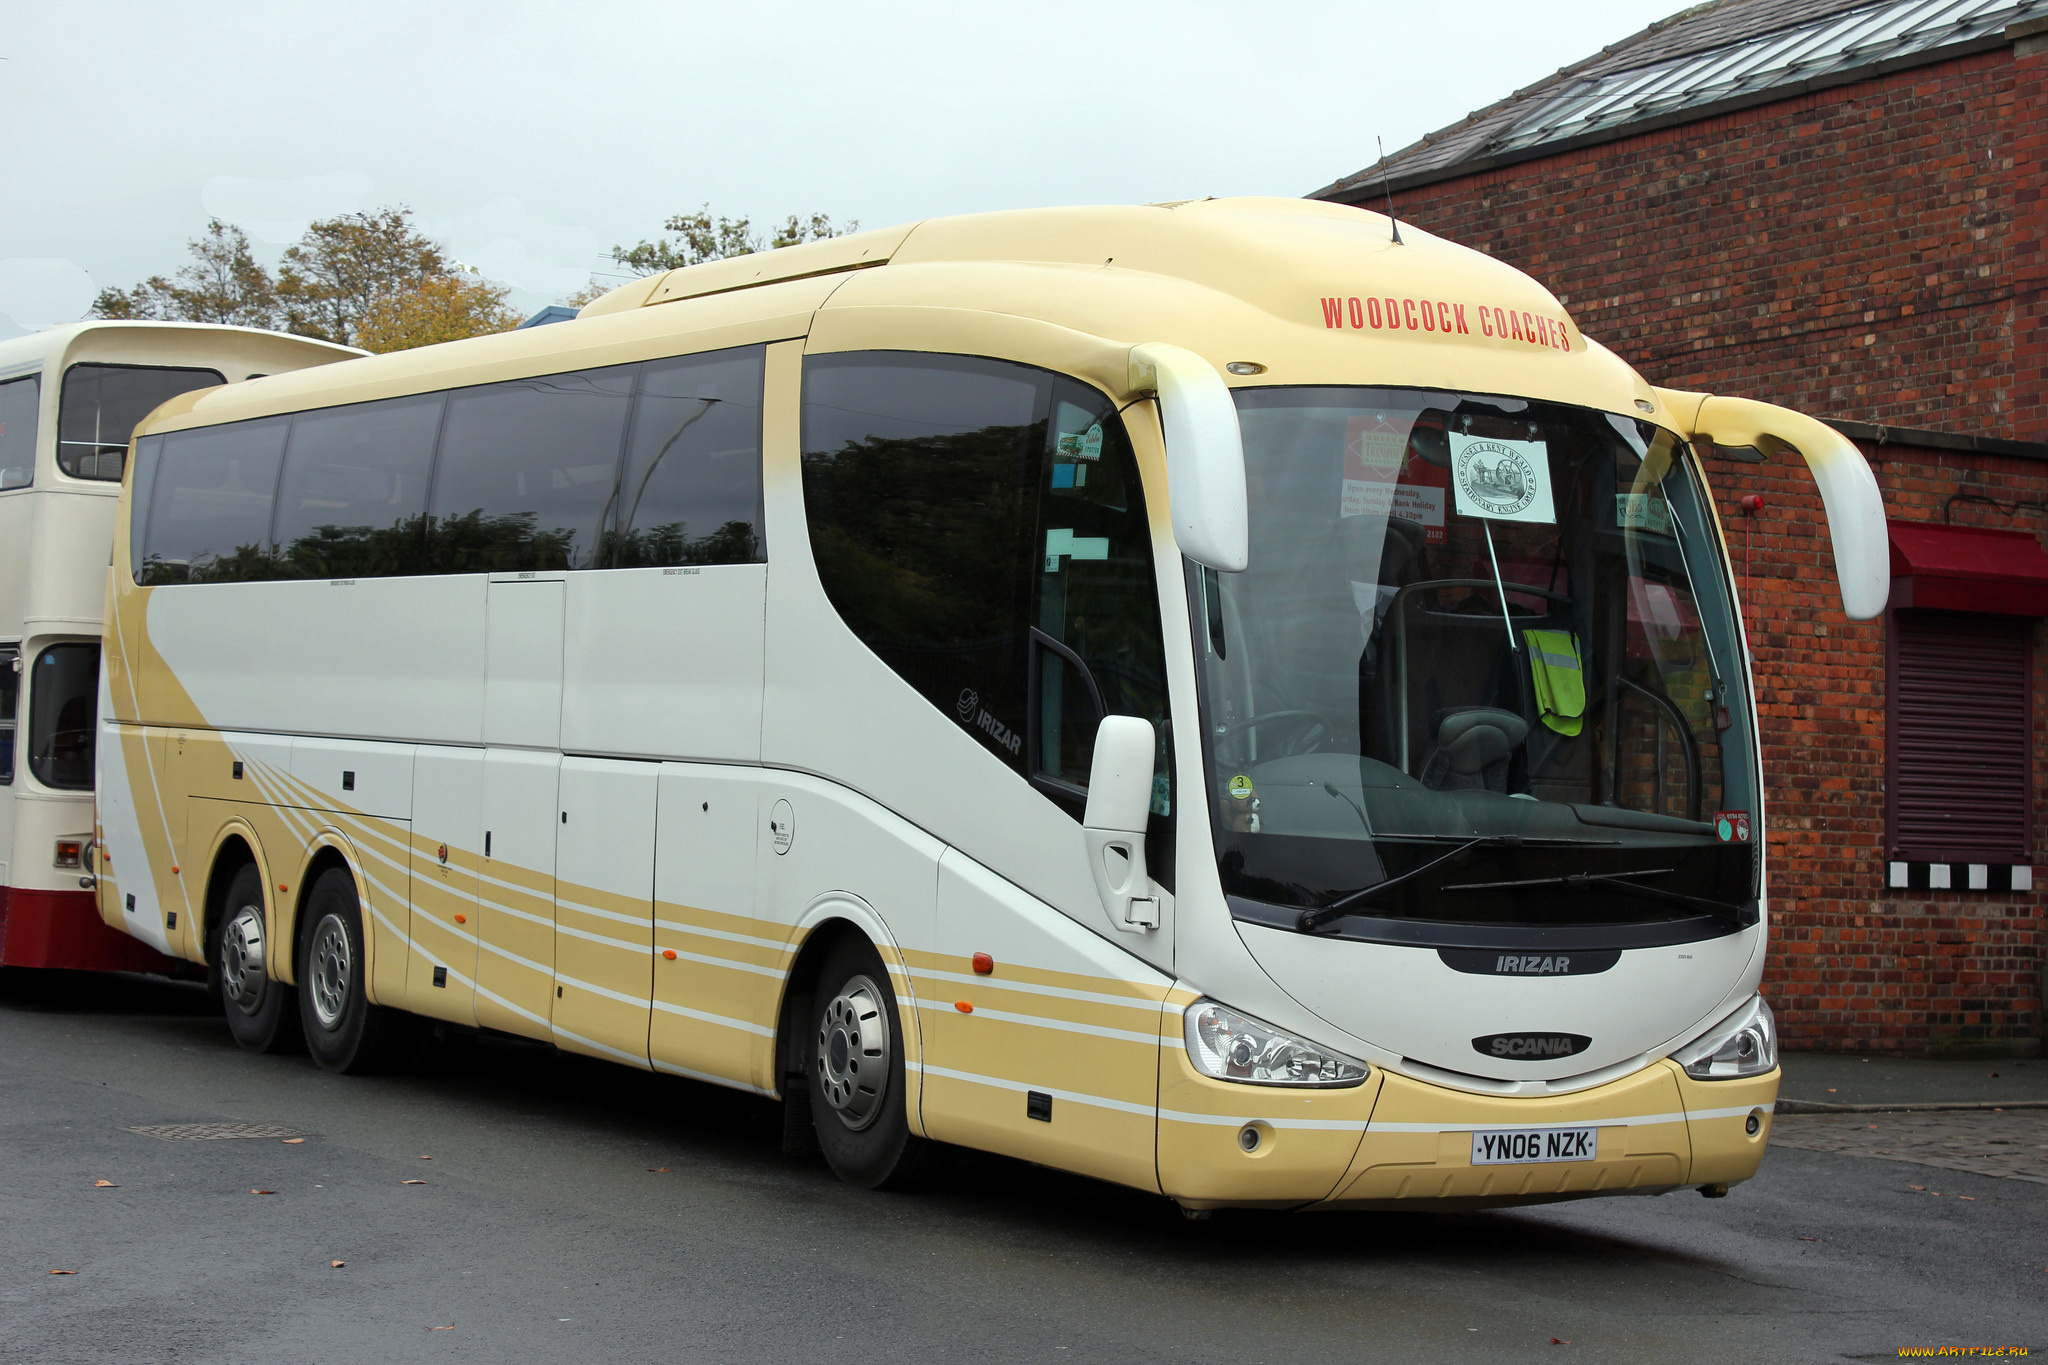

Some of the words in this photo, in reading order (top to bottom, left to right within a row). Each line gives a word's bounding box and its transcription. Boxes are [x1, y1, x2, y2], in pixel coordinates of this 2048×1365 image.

[1320, 296, 1469, 335] WOODCOCK
[1478, 305, 1571, 353] COACHES
[1460, 445, 1478, 468] SUSSEX
[1486, 443, 1506, 455] KENT
[1509, 451, 1532, 476] WEALD
[1347, 484, 1364, 493] Open
[1365, 486, 1383, 496] every
[1460, 477, 1495, 513] STATIONARY
[1344, 506, 1360, 515] from
[1398, 511, 1423, 520] 4.30pm
[1363, 496, 1386, 507] Sunday
[1394, 499, 1410, 508] Bank
[1411, 501, 1436, 512] Holiday
[977, 708, 1022, 756] IRIZAR
[1237, 776, 1244, 788] 3
[1496, 955, 1571, 973] IRIZAR
[1490, 1037, 1573, 1055] SCANIA
[1483, 1133, 1541, 1160] YN06
[1546, 1131, 1591, 1158] NZK
